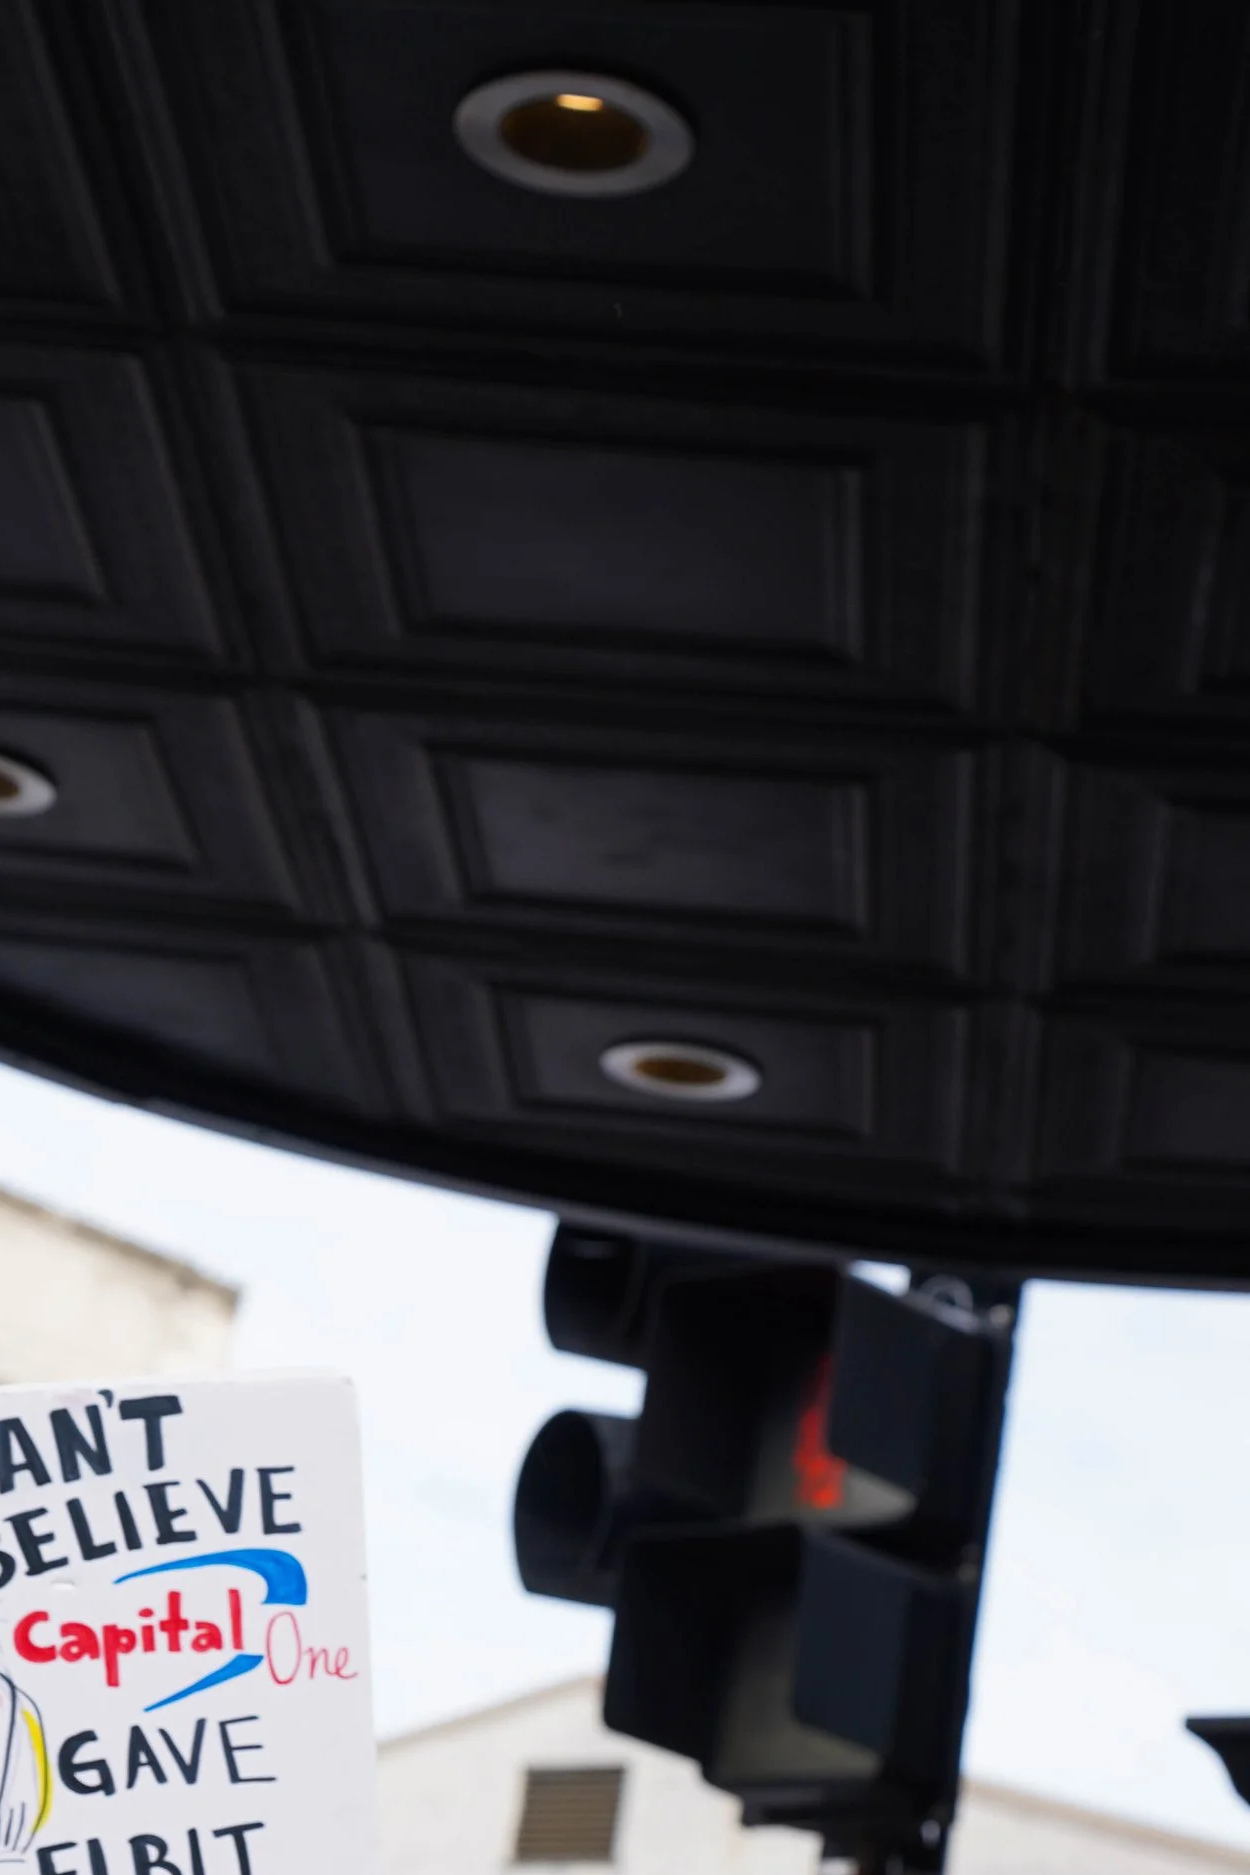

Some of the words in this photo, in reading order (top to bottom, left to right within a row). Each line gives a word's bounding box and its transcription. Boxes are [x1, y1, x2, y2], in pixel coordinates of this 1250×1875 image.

[13, 1588, 245, 1688] Capital
[266, 1611, 358, 1685] One
[58, 1716, 277, 1797] GAVE
